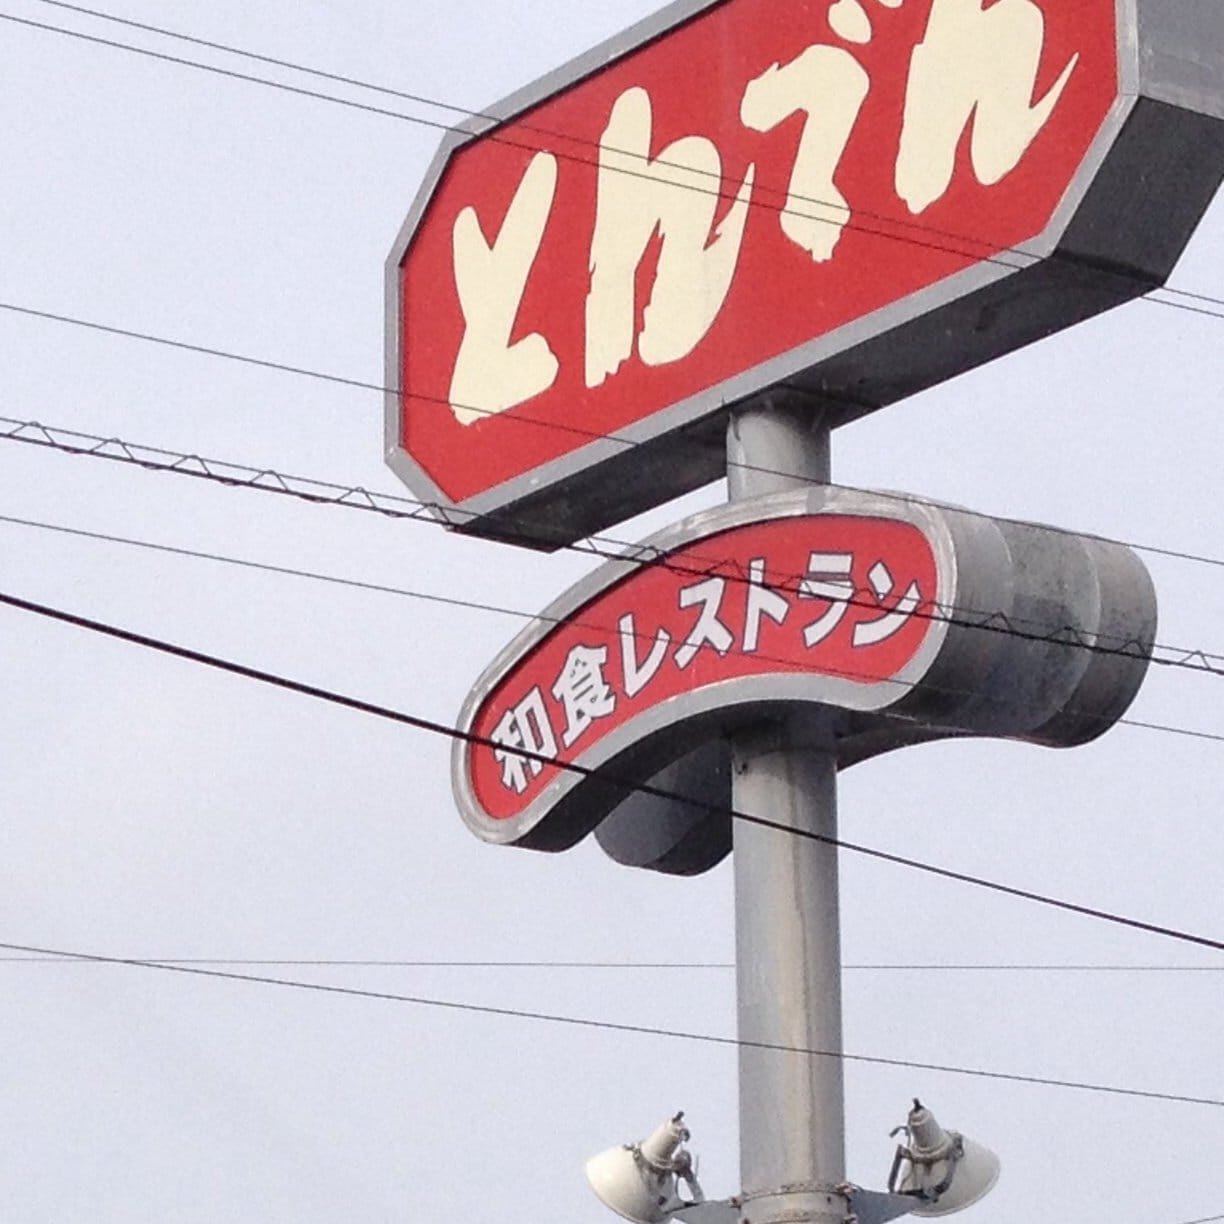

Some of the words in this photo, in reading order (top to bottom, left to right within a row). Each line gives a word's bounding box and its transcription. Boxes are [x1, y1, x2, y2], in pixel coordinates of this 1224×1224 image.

[449, 0, 1079, 425] とんでん
[490, 551, 922, 794] 和食レストラン
